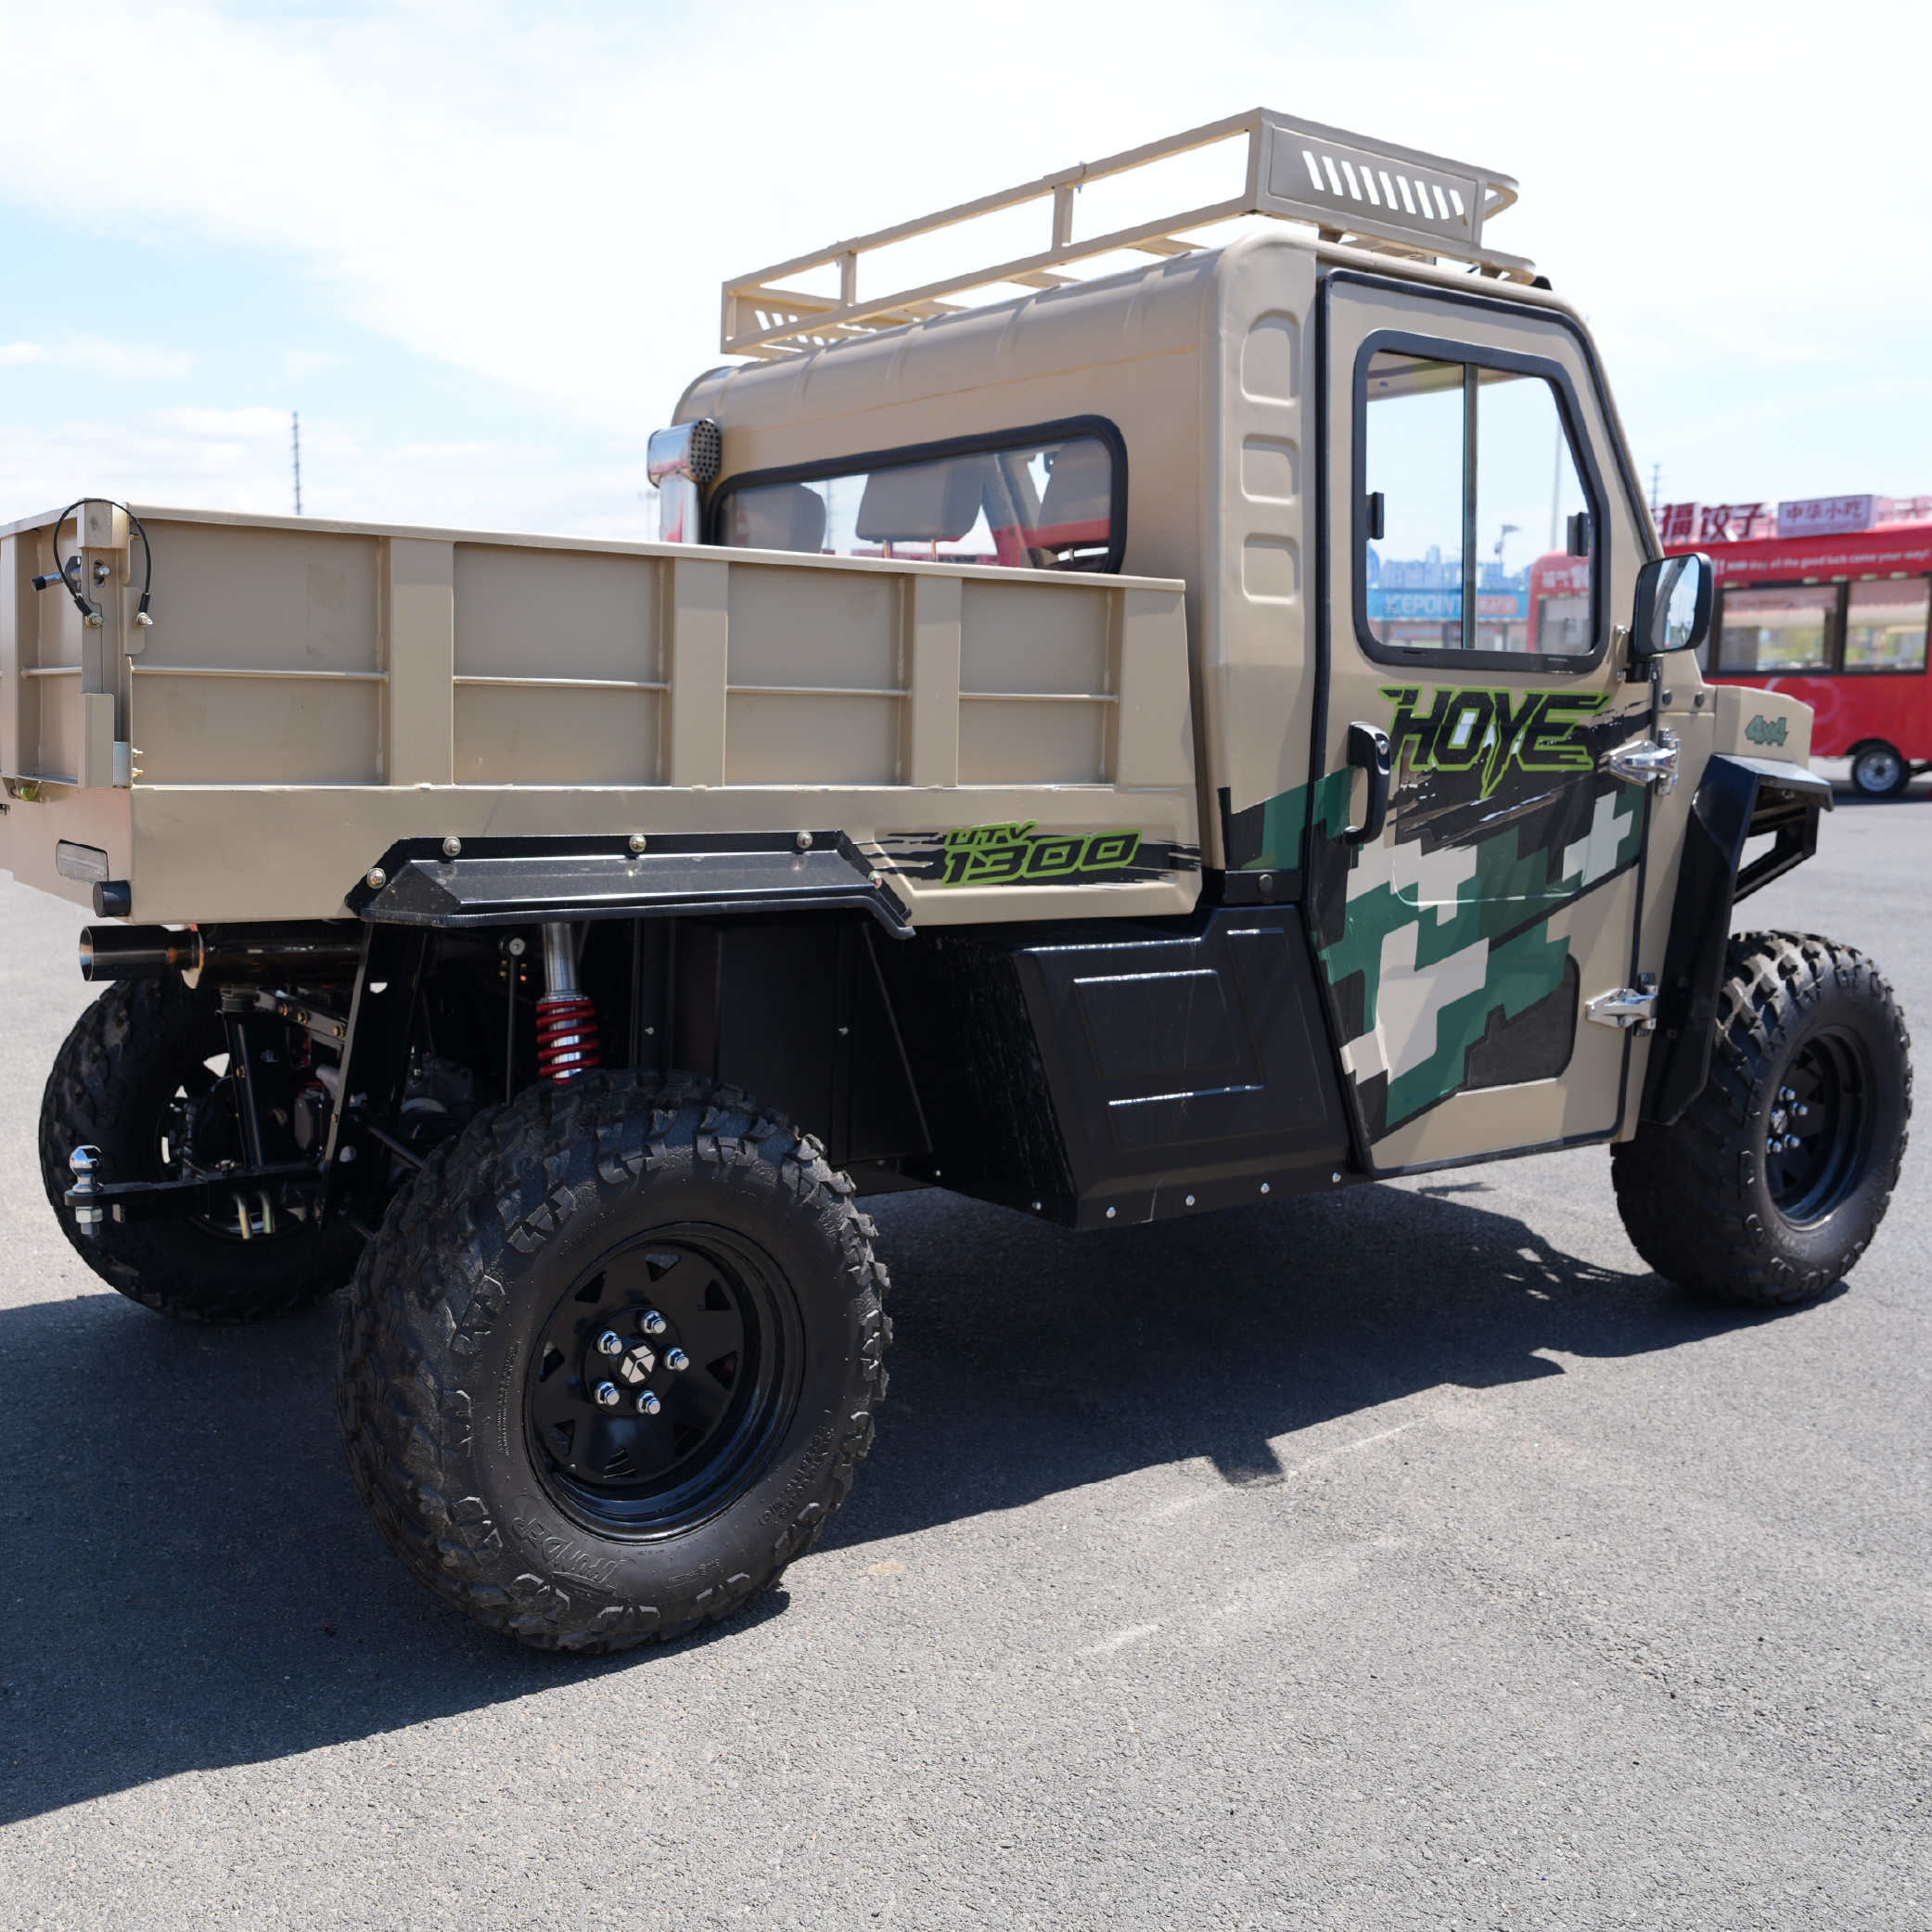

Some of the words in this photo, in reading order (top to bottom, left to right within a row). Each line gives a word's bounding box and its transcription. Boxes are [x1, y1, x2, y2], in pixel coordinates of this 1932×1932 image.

[1651, 503, 1766, 540] 福饺子
[1378, 685, 1613, 799] HOYE
[946, 820, 1038, 846] UTV
[944, 830, 1142, 887] 1300
